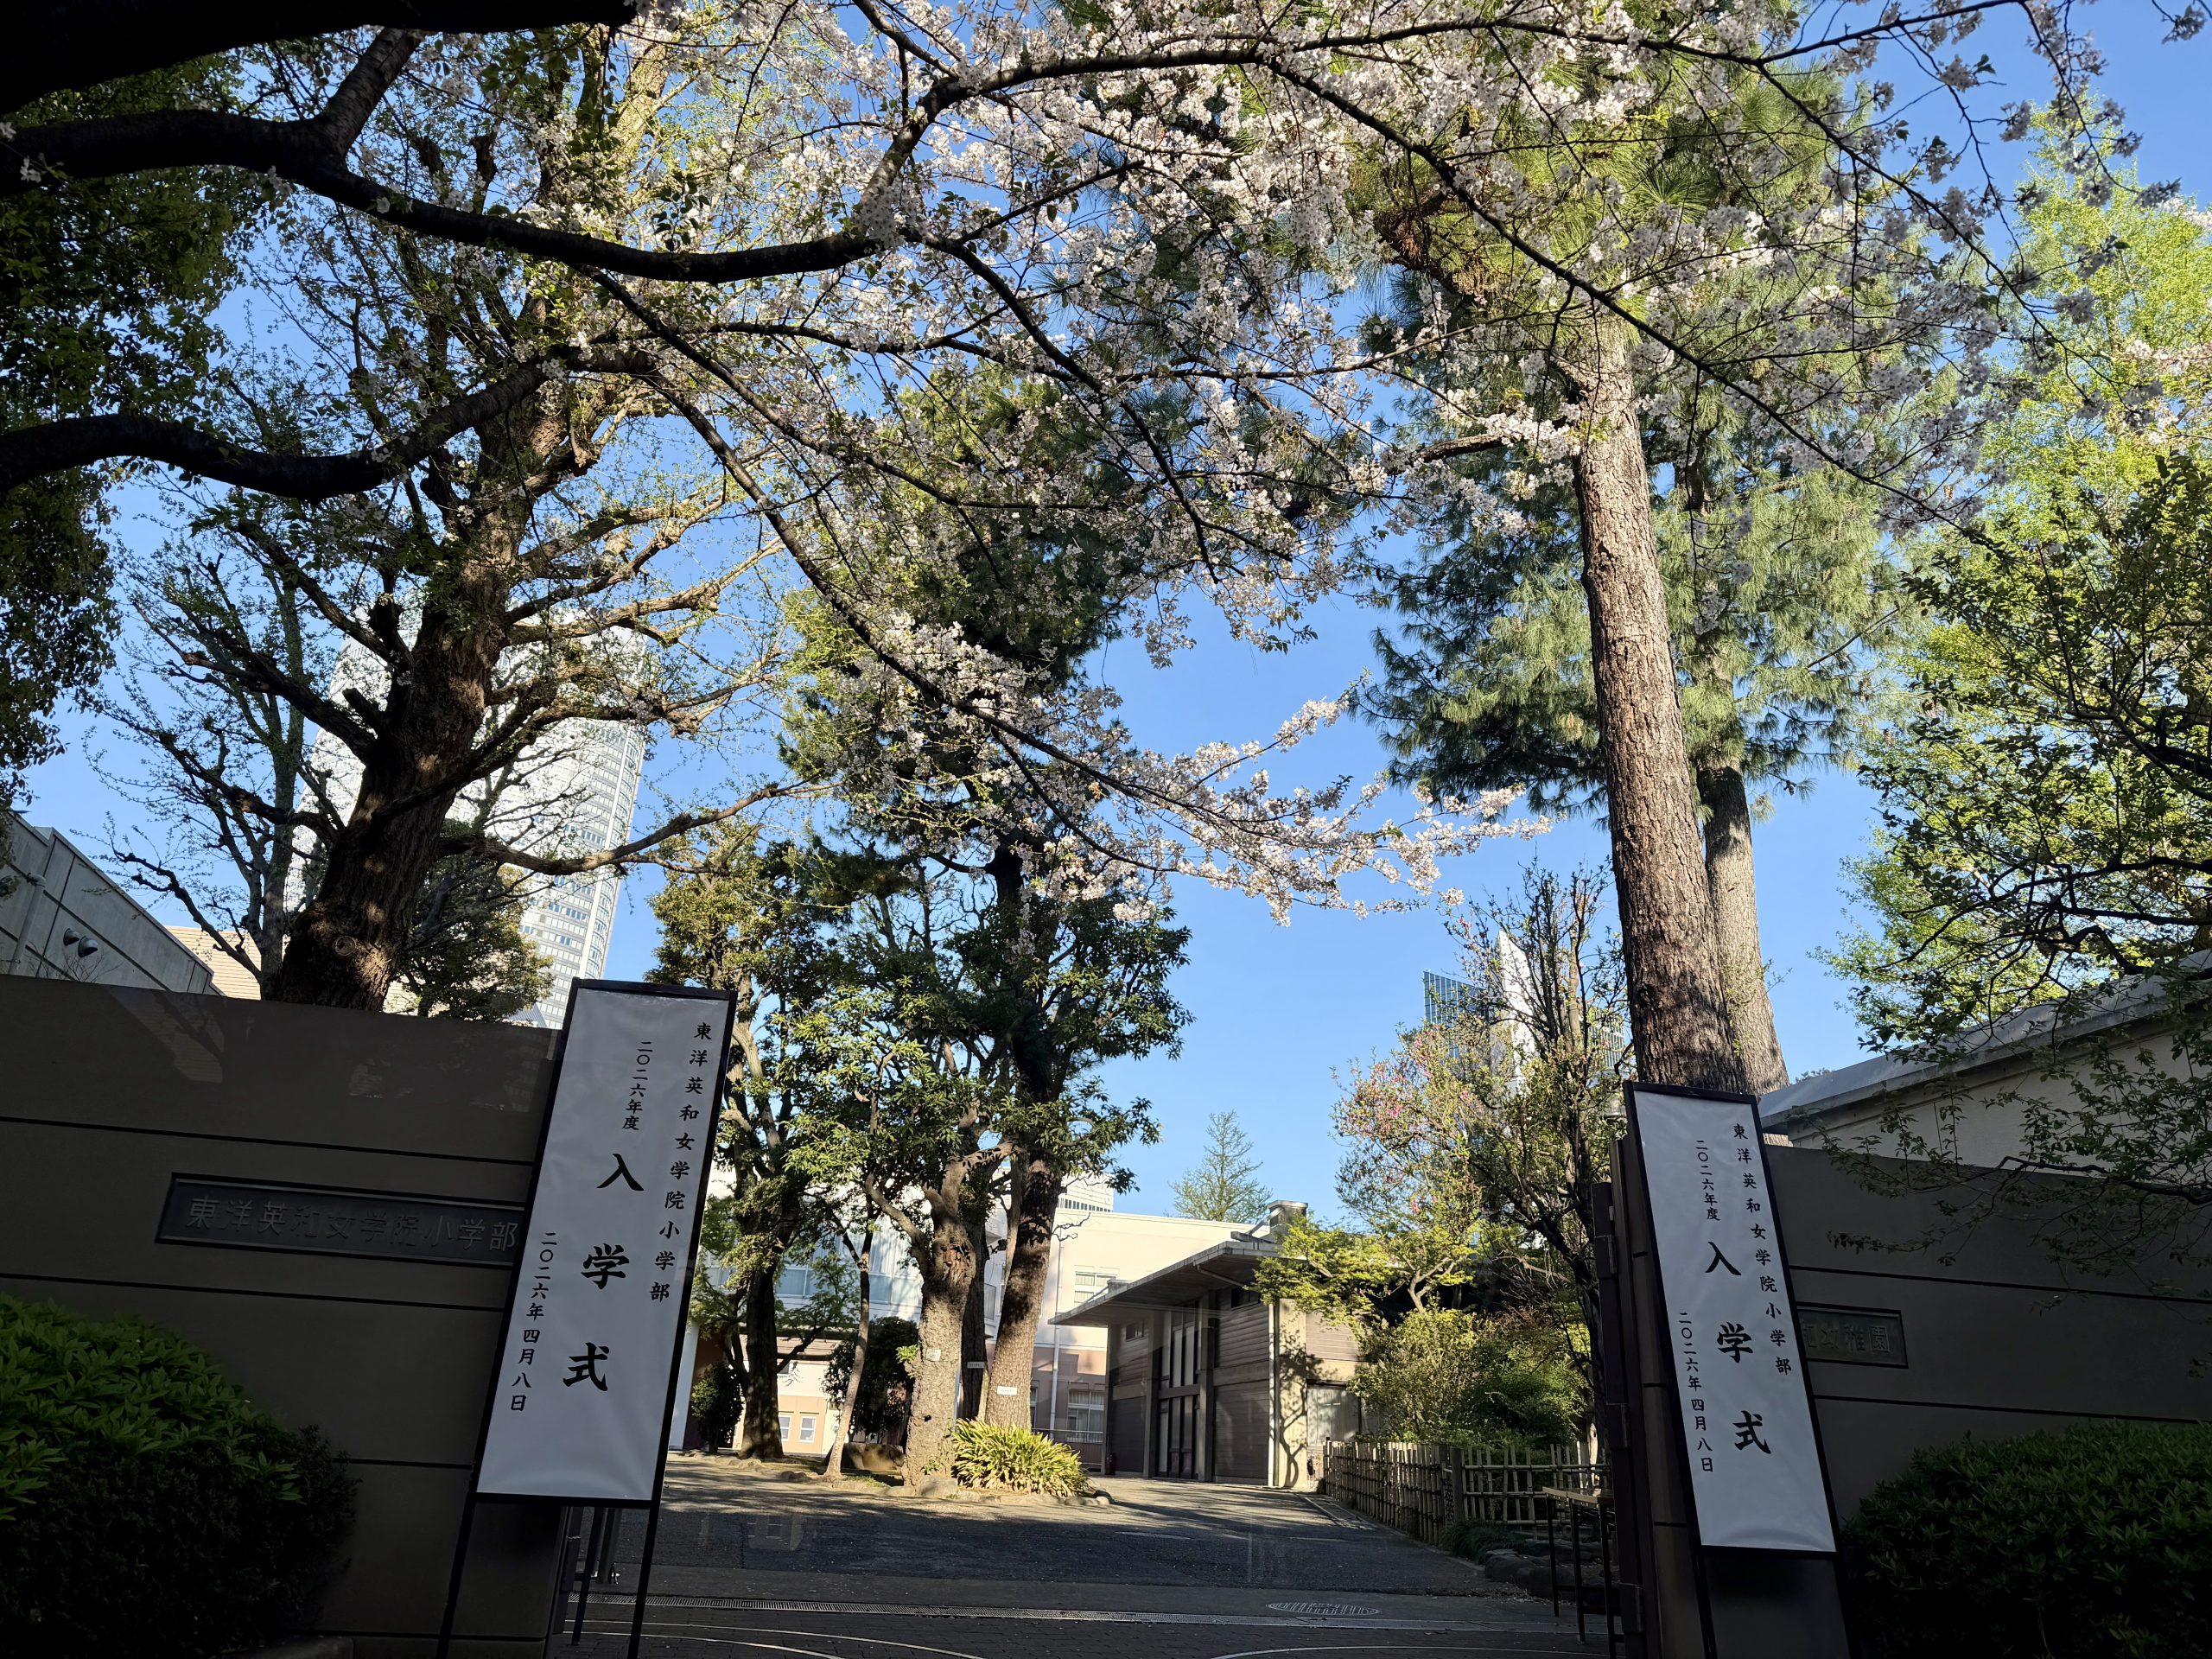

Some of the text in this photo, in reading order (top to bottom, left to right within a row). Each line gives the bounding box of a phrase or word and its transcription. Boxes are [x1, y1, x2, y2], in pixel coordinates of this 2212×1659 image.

[621, 1041, 654, 1131] 二〇二六年度
[650, 1022, 713, 1303] 東洋英和女学院小学部
[1695, 1140, 1721, 1221] 二〇二六年度
[187, 1196, 520, 1252] 東洋英和女学院小学部
[563, 1153, 645, 1392] 入学式
[1733, 1122, 1792, 1376] 東洋英和女学院小学部
[1705, 1241, 1772, 1455] 入学式
